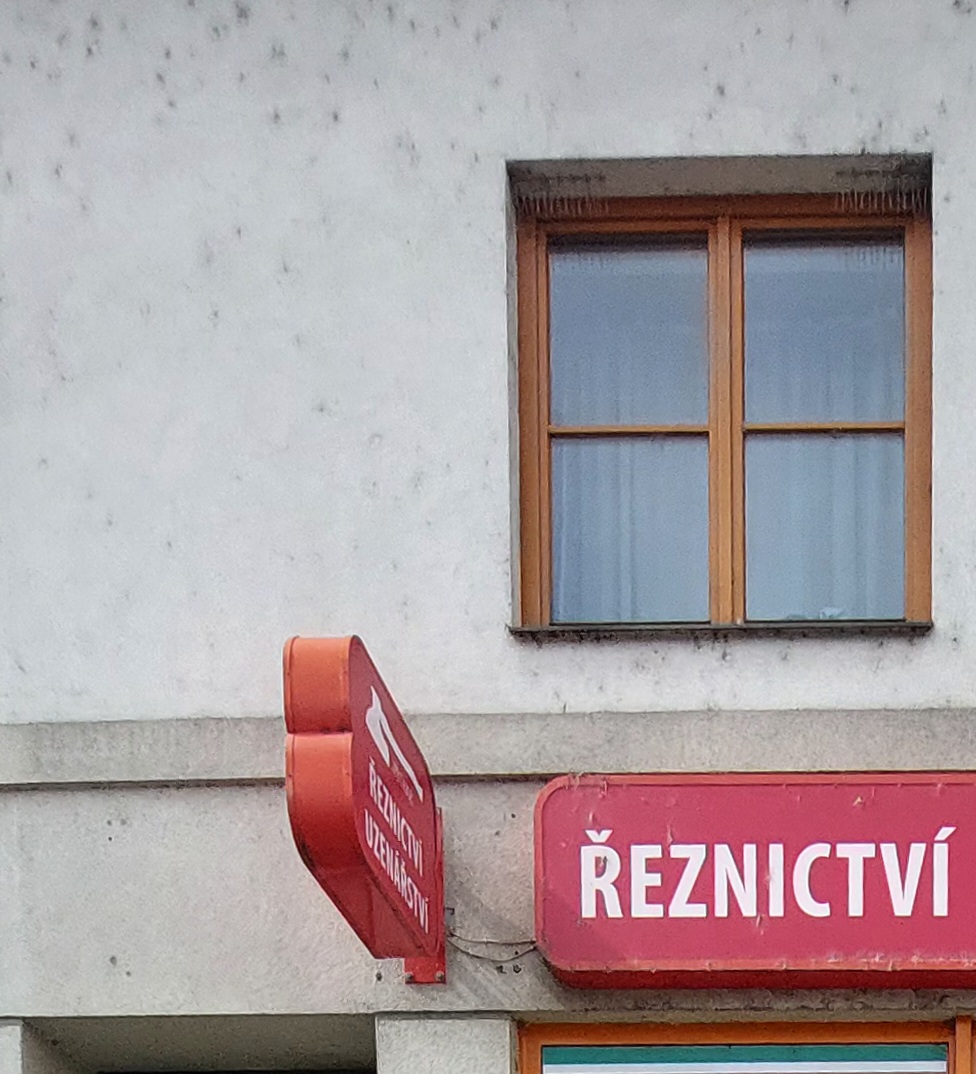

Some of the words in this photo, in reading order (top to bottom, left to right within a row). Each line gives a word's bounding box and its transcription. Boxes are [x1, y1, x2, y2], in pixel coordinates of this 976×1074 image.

[363, 807, 430, 934] UZENÁŘSTVÍ
[368, 755, 424, 878] ŘEZNICTVÍ
[579, 827, 957, 919] ŘEZNICTVÍ
